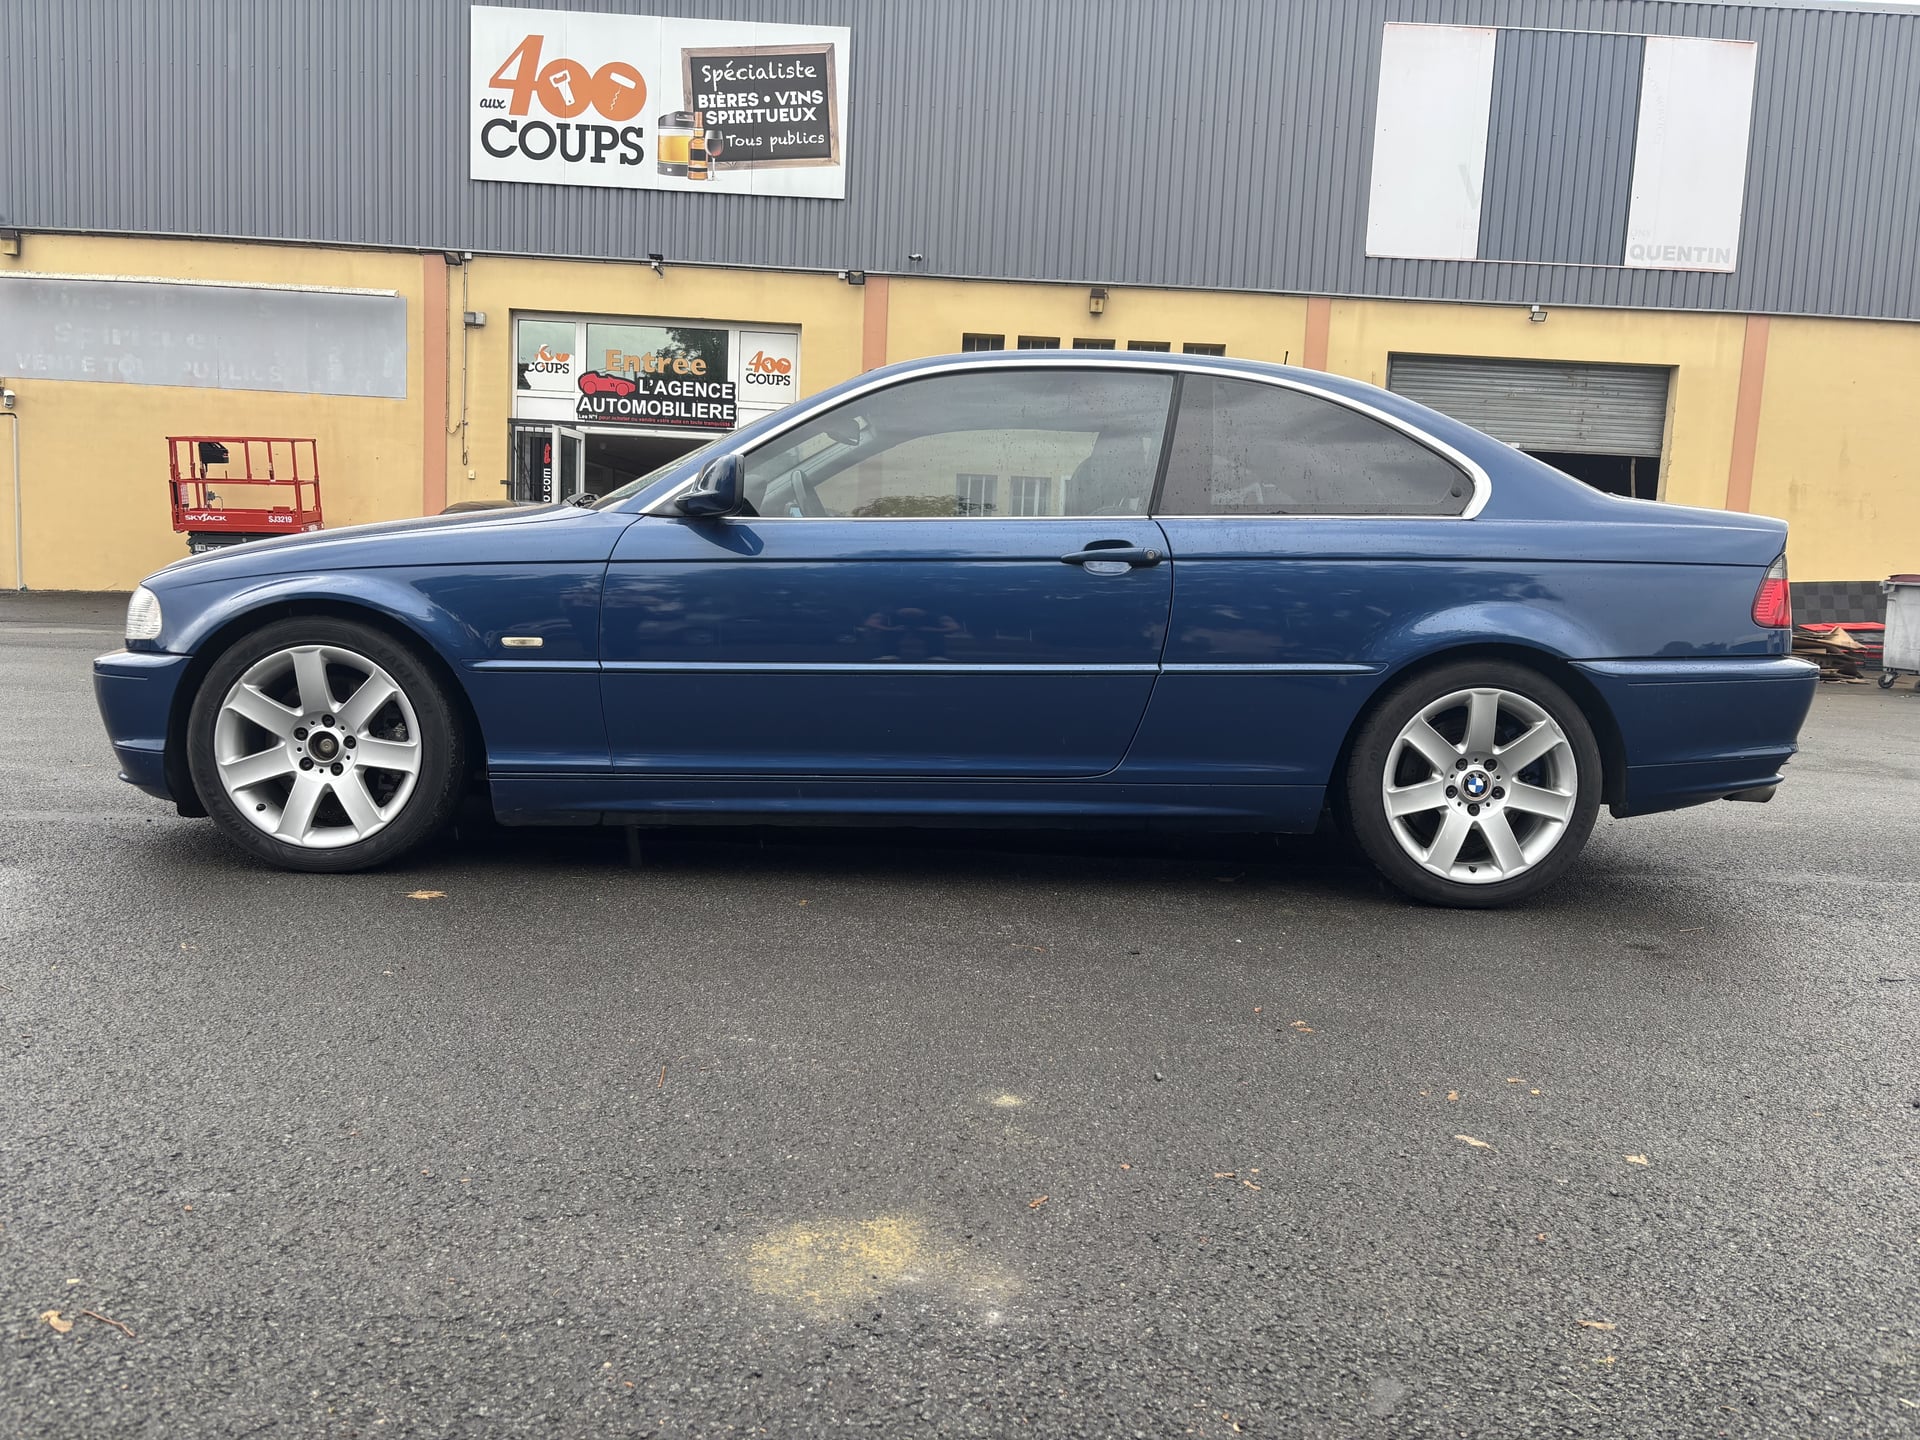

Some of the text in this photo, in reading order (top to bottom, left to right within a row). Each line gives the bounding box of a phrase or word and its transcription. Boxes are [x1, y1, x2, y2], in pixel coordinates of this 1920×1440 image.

[479, 34, 647, 122] aux 400
[701, 60, 817, 92] Spécialiste
[698, 90, 824, 109] BIÈRES VINS
[706, 107, 817, 125] SPIRITUEUX
[480, 118, 645, 165] COUPS
[725, 132, 825, 152] Tous publics
[1629, 244, 1731, 263] QUENTIN
[605, 349, 707, 376] Entrée
[748, 350, 791, 374] 400
[638, 378, 735, 399] L'AGENCE
[745, 373, 791, 386] COUPS
[578, 397, 736, 420] AUTOMOBILIERE
[185, 513, 227, 522] SKYJACK
[268, 515, 292, 523] SJ3219
